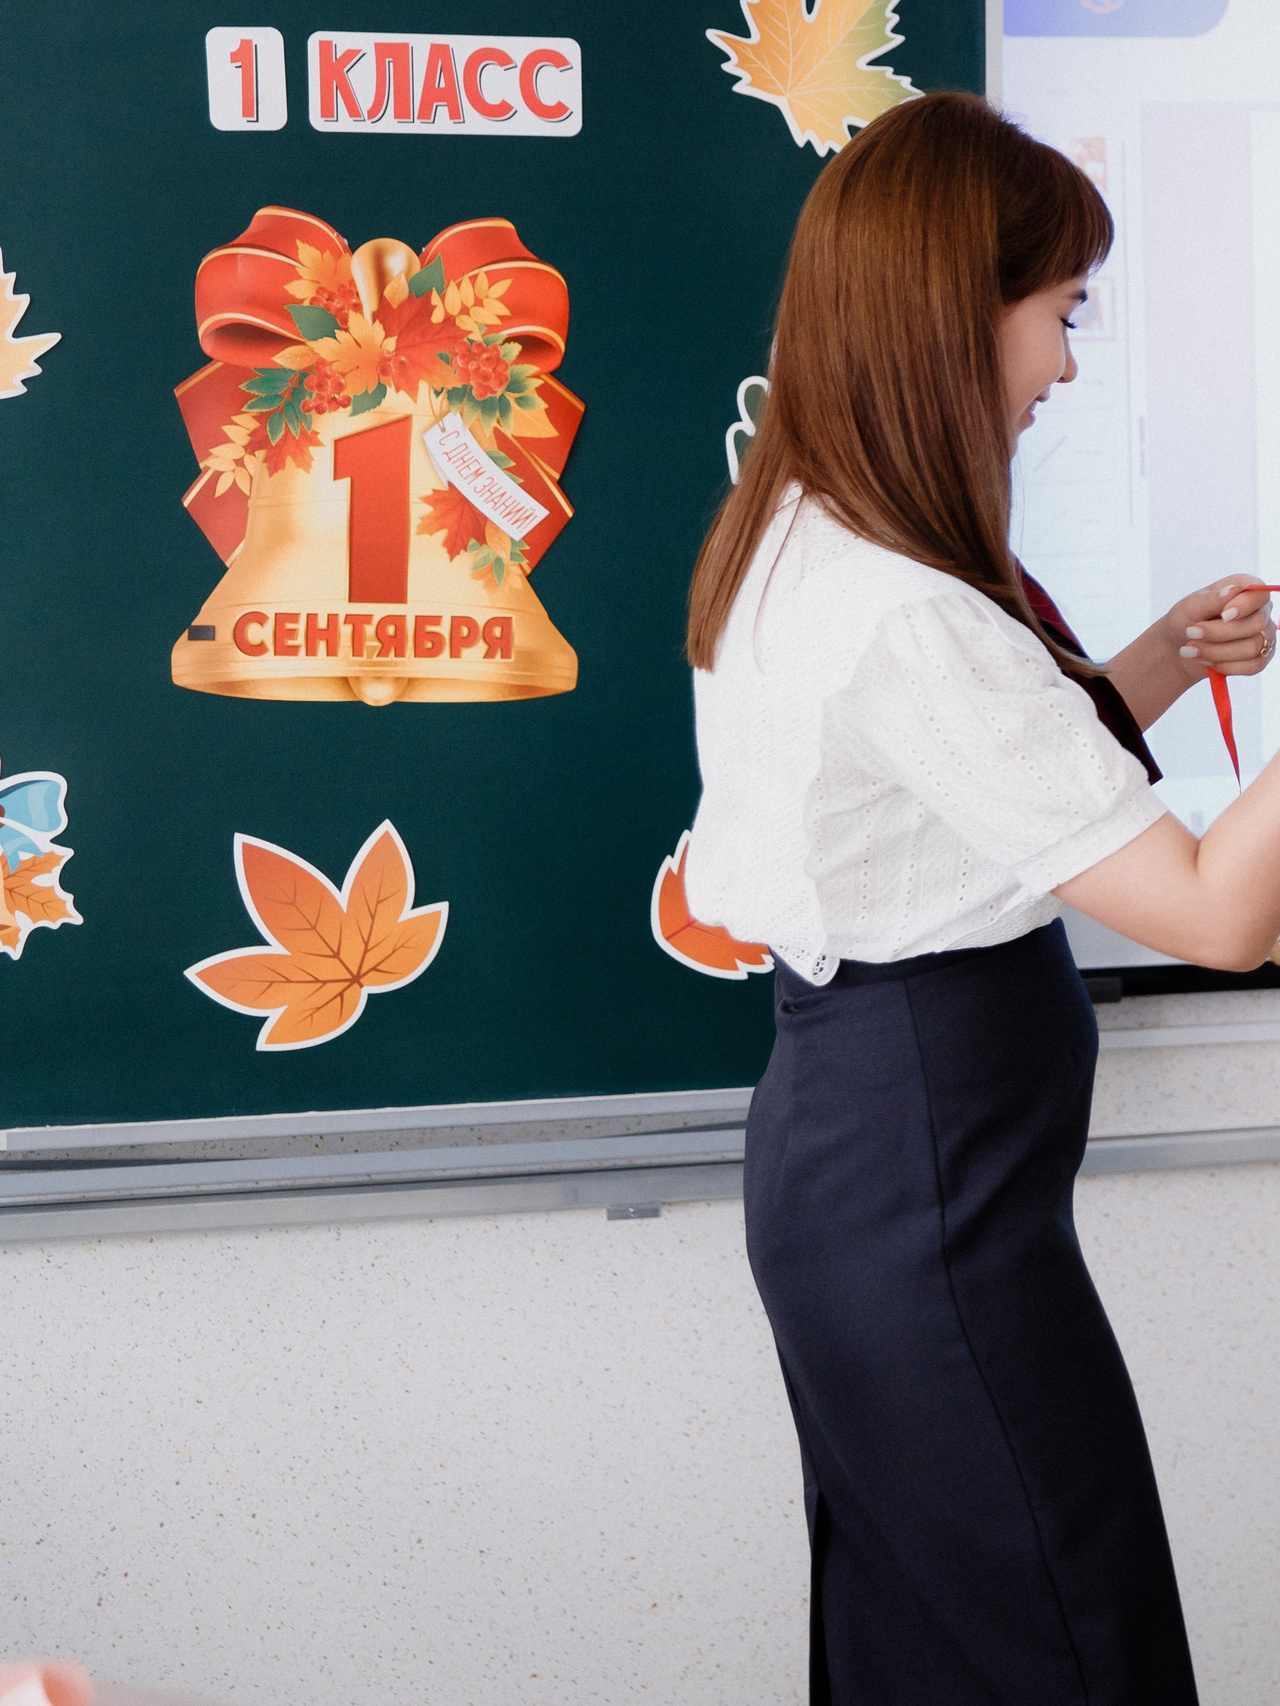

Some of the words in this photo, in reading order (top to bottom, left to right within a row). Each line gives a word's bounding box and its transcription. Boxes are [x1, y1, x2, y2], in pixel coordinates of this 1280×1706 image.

[230, 39, 258, 121] 1
[318, 40, 574, 122] КЛАСС
[438, 430, 460, 446] С
[442, 442, 487, 486] ДНЕМ
[333, 413, 413, 604] 1
[473, 476, 538, 533] ЗНАНИЙ!
[232, 610, 515, 660] СЕНТЯБРЯ
